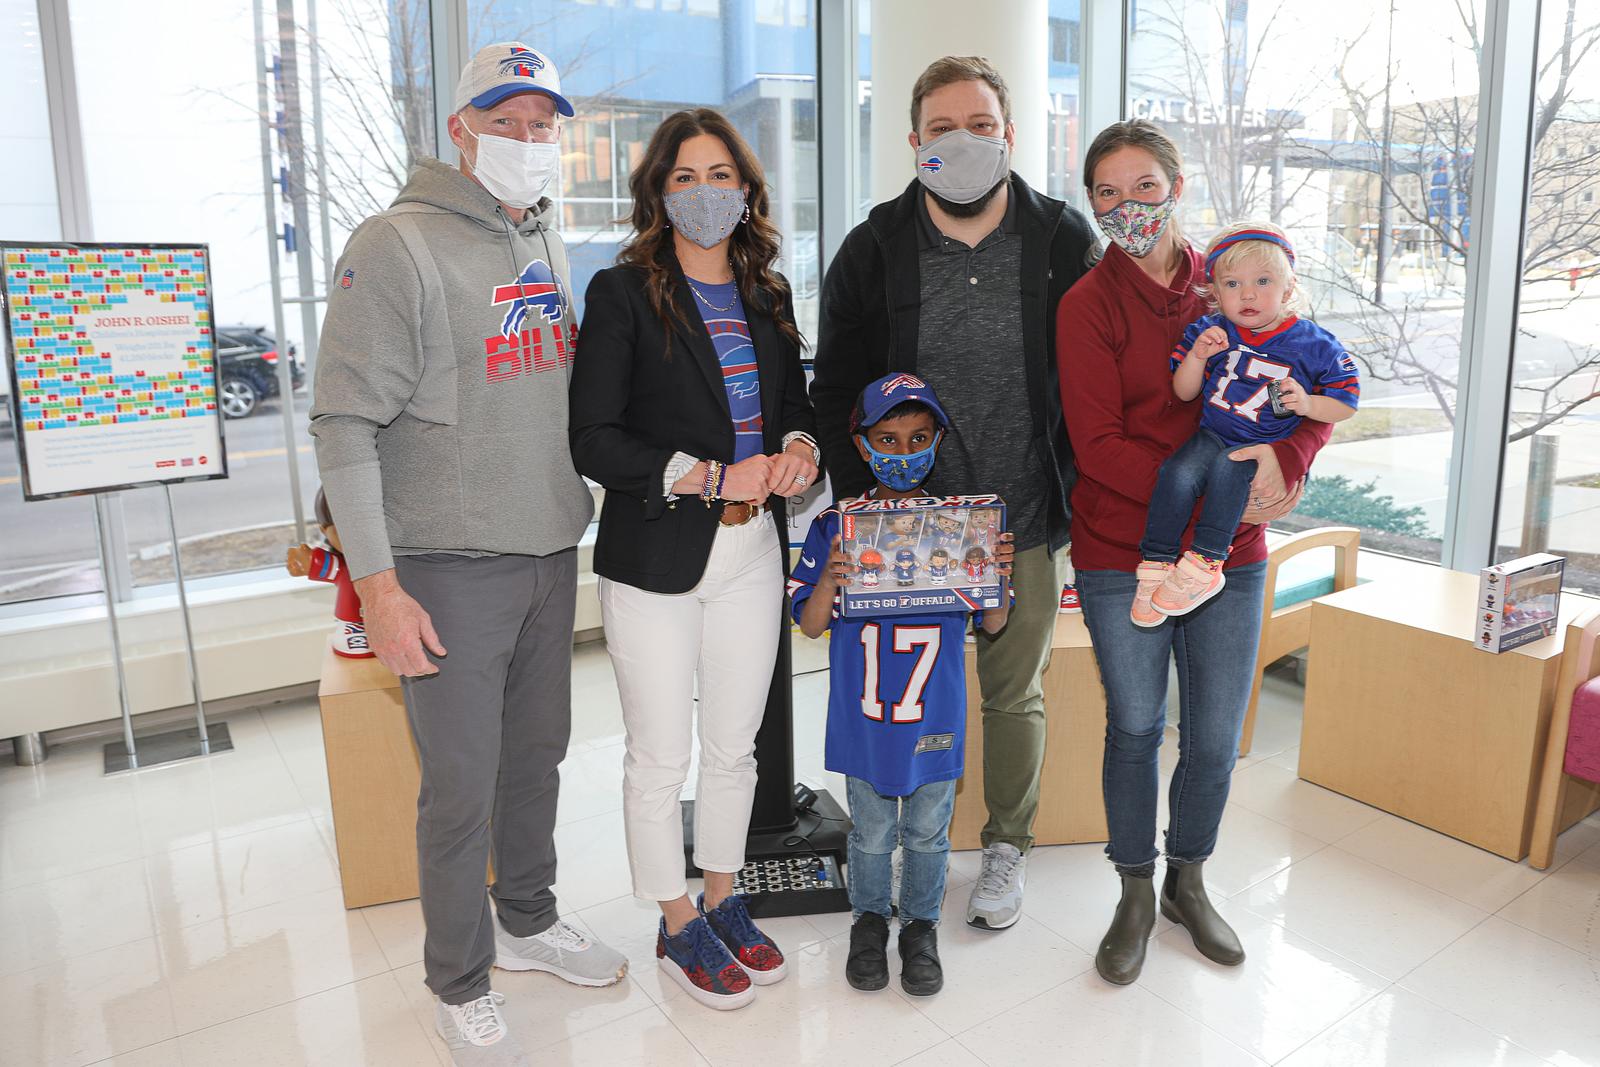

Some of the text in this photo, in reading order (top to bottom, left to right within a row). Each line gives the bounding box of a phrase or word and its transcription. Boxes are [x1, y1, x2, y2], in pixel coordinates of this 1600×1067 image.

[1183, 99, 1267, 127] CENTER
[94, 316, 131, 327] JOHN
[145, 315, 190, 326] OISHEI
[1208, 348, 1293, 424] 17
[849, 595, 955, 609] LET'S GO BUFFALO!
[859, 622, 942, 723] 17
